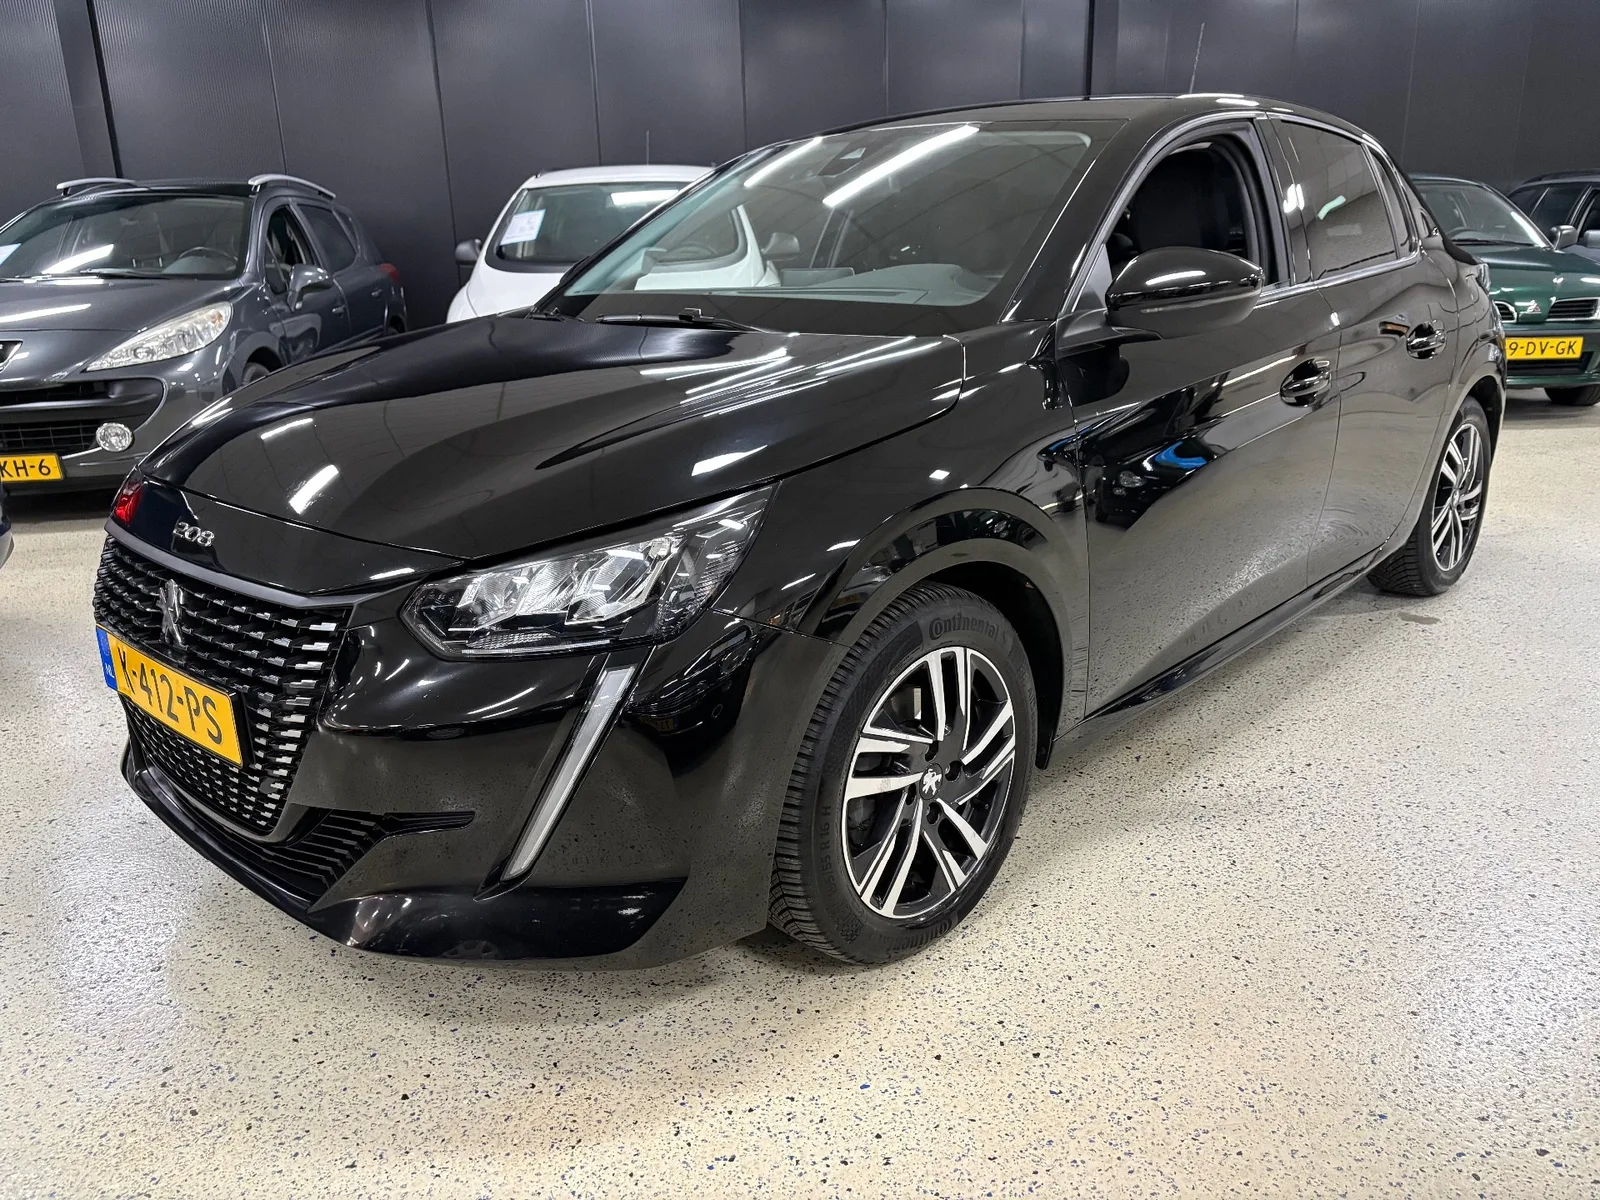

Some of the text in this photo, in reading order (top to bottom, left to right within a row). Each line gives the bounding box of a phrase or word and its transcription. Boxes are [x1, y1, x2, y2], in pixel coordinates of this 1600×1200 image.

[1508, 340, 1577, 357] 9-DV-GK
[173, 521, 215, 547] 208
[928, 610, 1000, 642] Continental
[117, 646, 223, 745] K-412-PS
